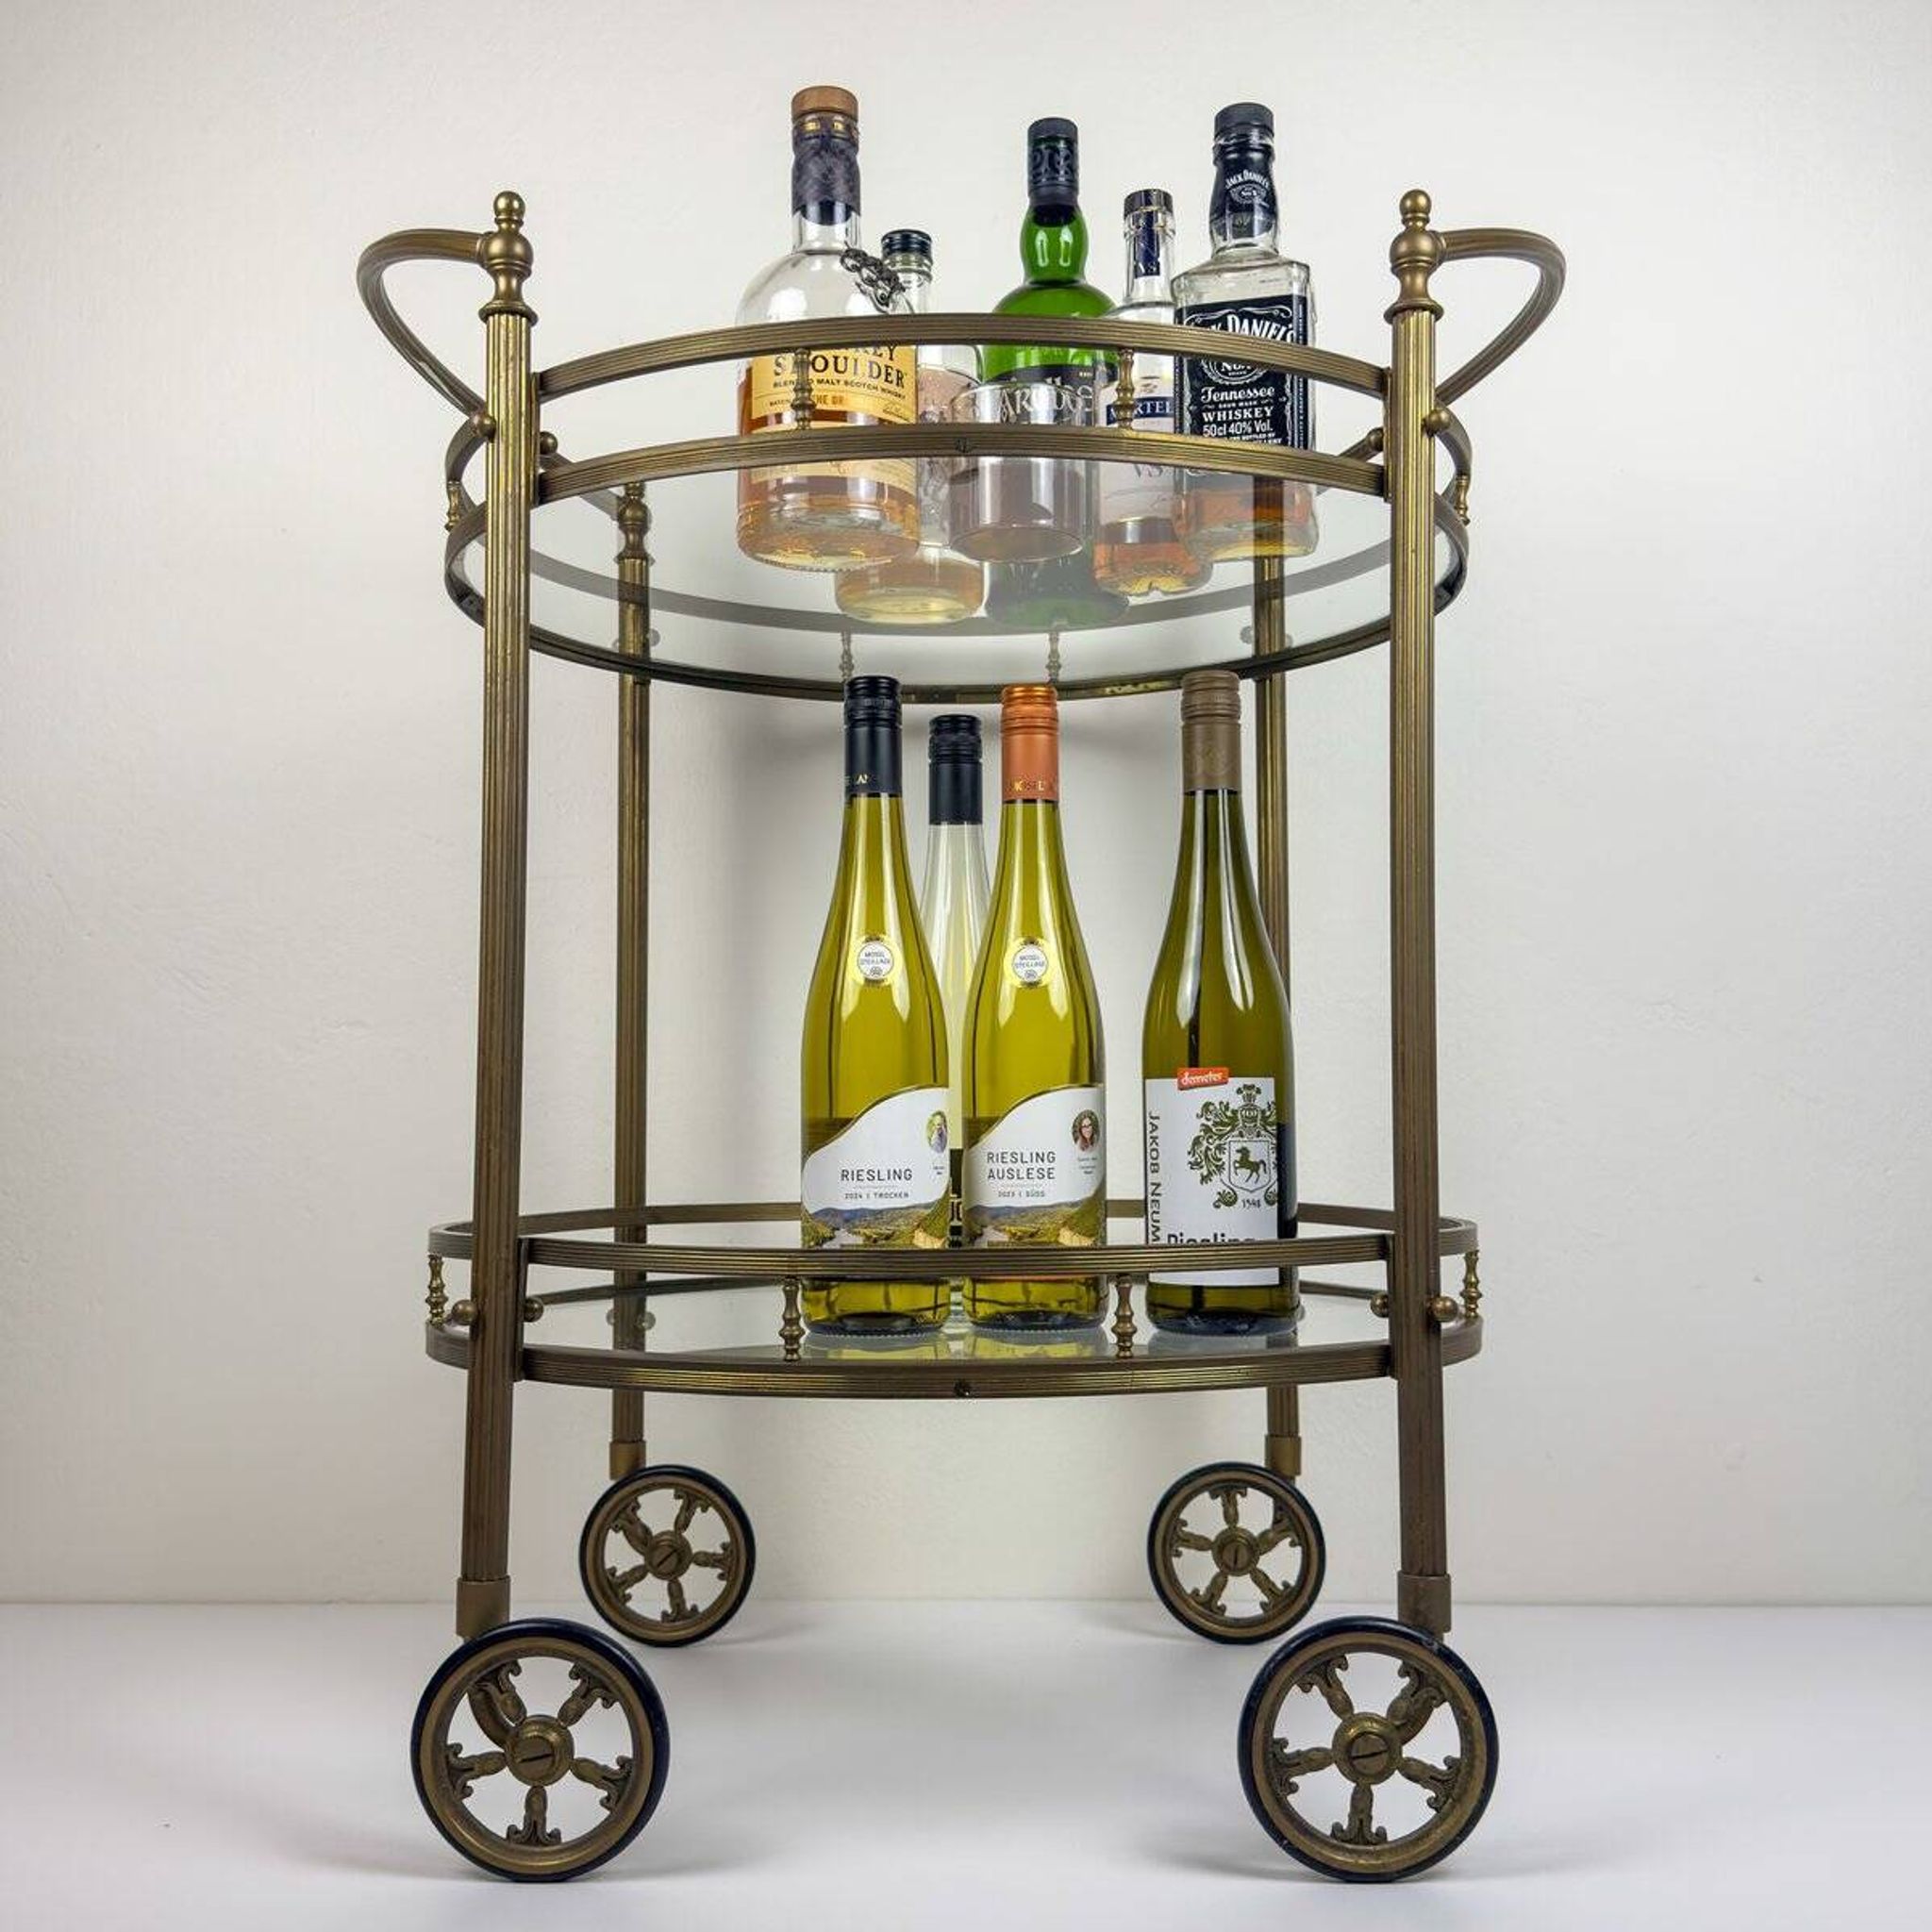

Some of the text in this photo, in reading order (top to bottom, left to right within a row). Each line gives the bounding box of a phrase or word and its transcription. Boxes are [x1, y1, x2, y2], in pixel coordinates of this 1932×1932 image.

[774, 354, 906, 390] SOULDER
[1201, 387, 1275, 404] Tennessee
[1202, 407, 1274, 423] WHISKEY
[1203, 419, 1274, 437] 50cl 40% Vol.
[1181, 1071, 1224, 1085] demeter
[987, 1151, 1056, 1164] RIESLING
[841, 1169, 913, 1182] RIESLING
[988, 1167, 1056, 1180] AUSLESE
[1147, 1111, 1162, 1243] JAKOB NEUM
